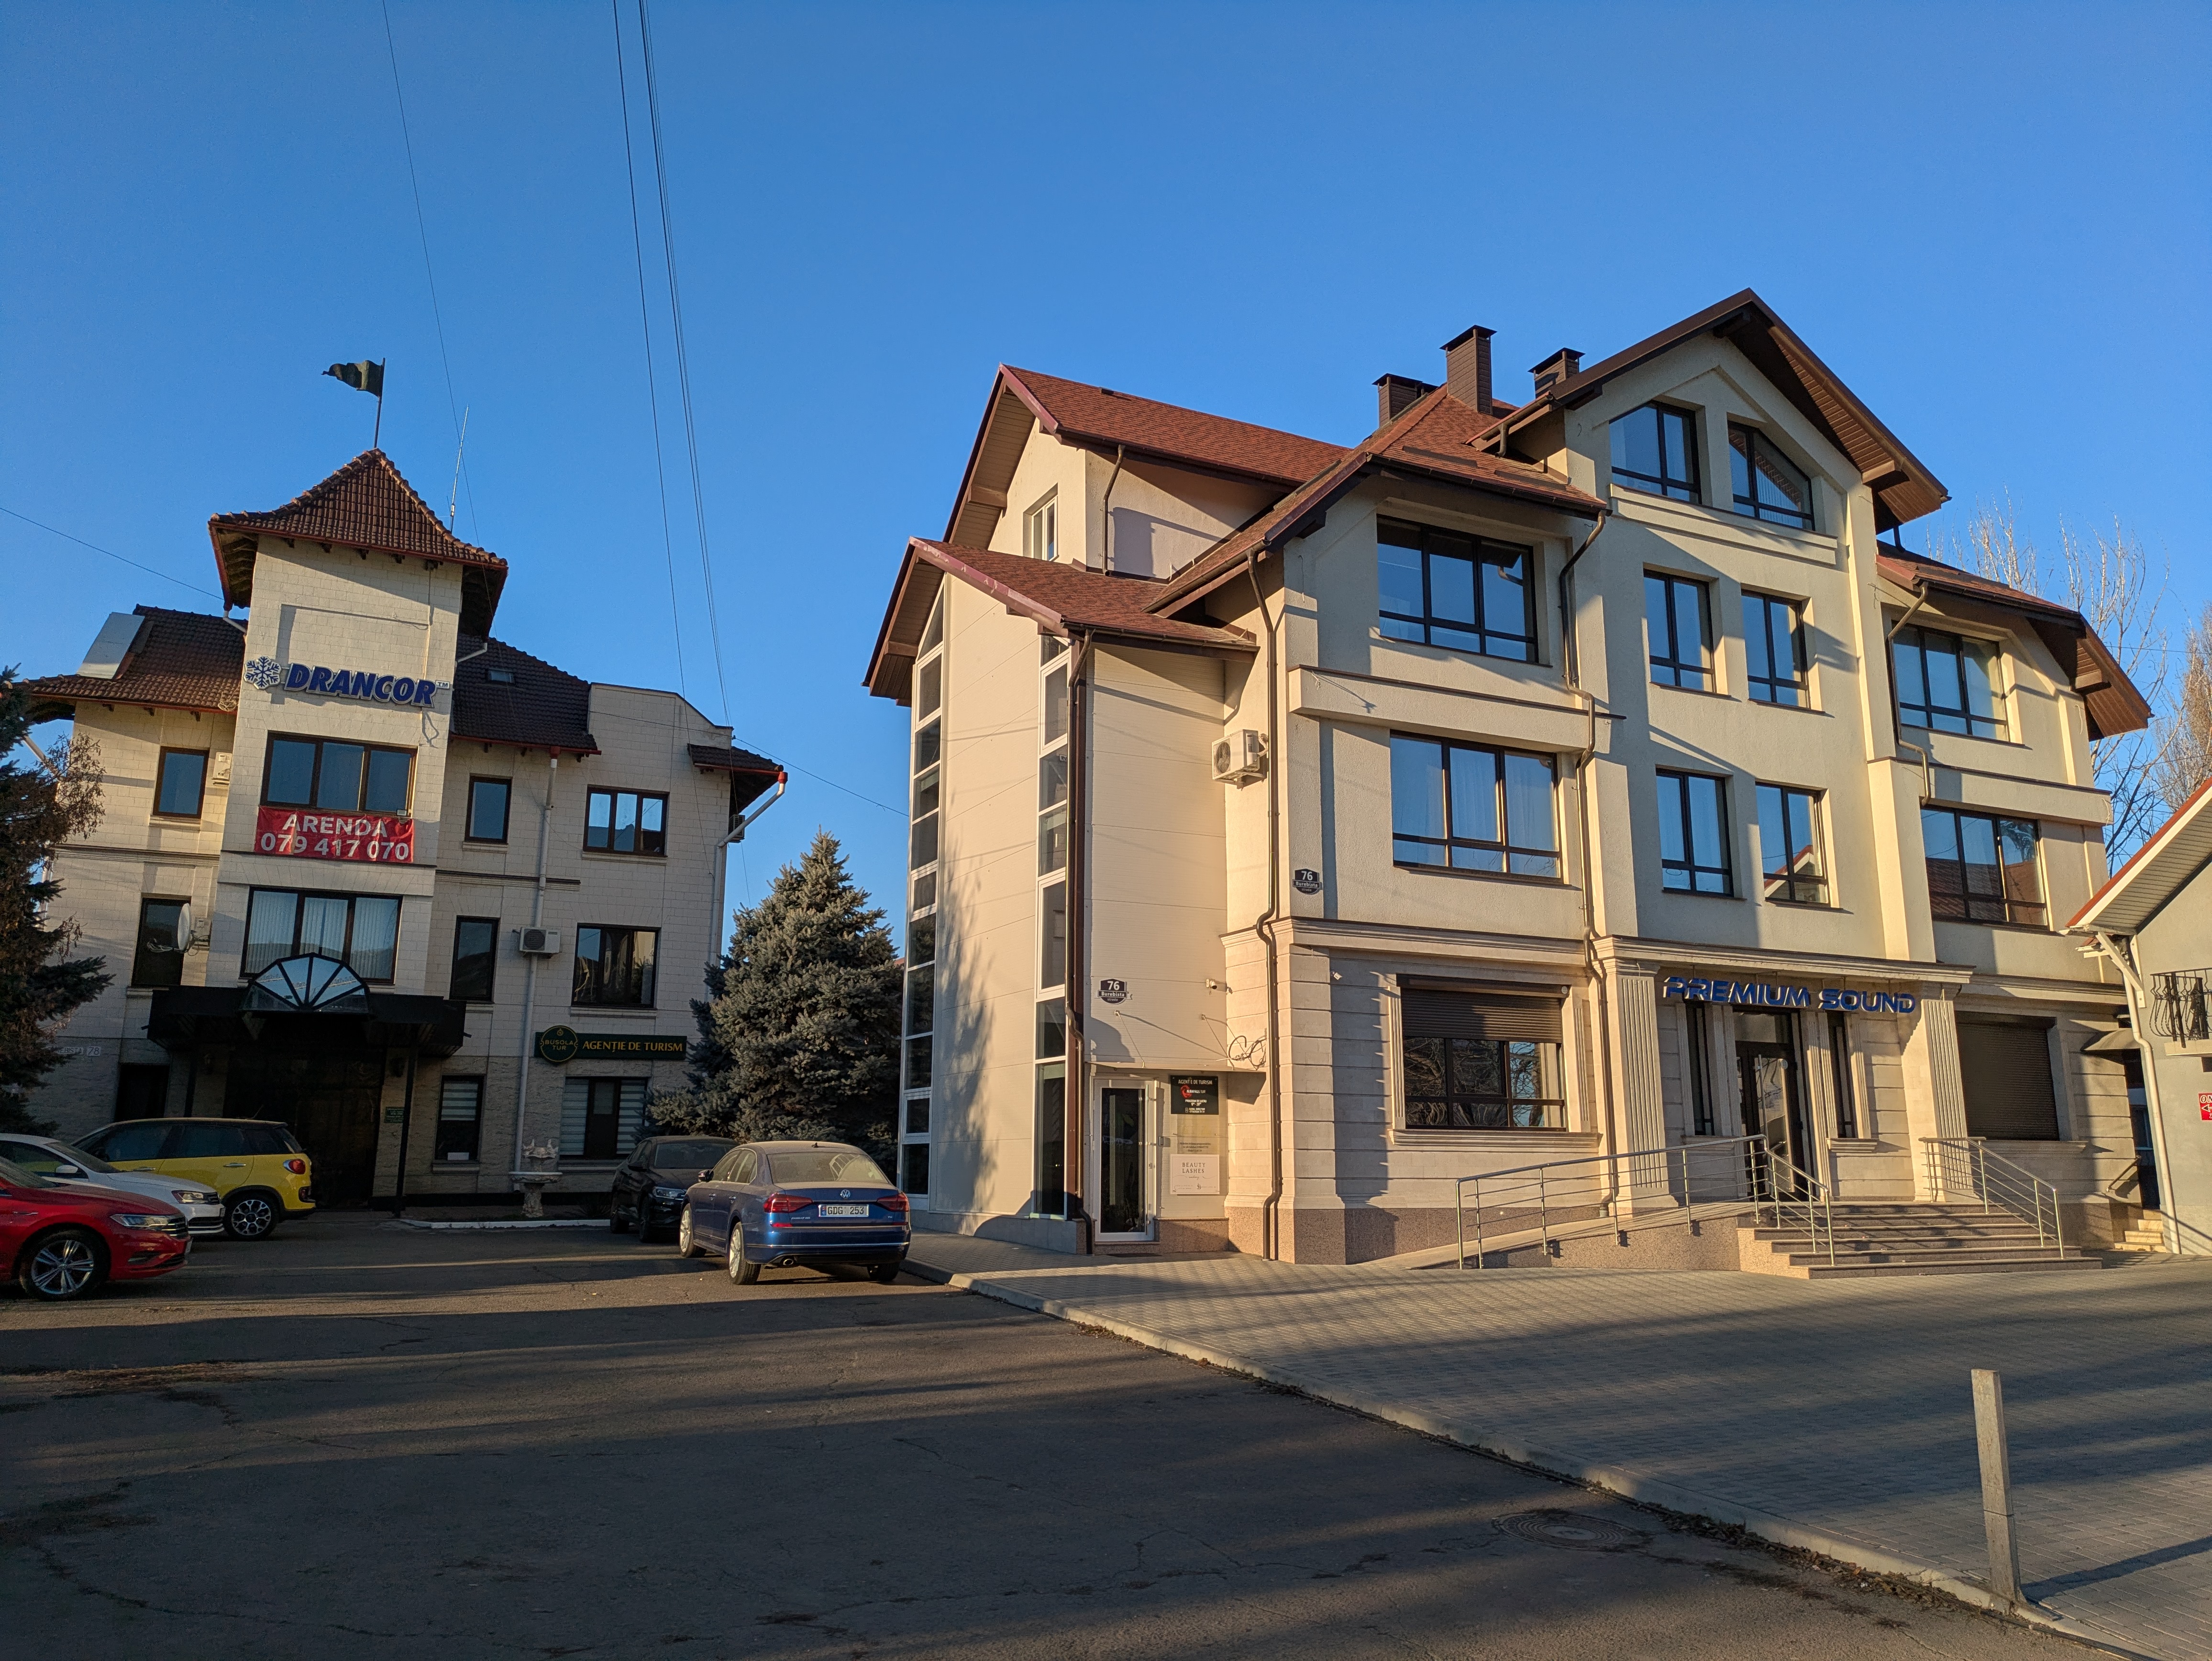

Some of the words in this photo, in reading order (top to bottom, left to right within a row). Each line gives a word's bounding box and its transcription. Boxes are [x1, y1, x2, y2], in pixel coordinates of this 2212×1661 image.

[284, 663, 436, 707] DRANCOR
[282, 814, 387, 837] ARENDA
[261, 833, 307, 853] 079
[314, 839, 360, 857] 417
[367, 841, 409, 860] 070
[1301, 871, 1313, 881] 76
[1107, 981, 1120, 991] 76
[1663, 976, 1810, 1008] PREMIUM
[1818, 988, 1916, 1013] SOUND
[88, 1047, 100, 1055] 78
[582, 1041, 626, 1052] AGENȚIE
[628, 1041, 641, 1051] DE
[644, 1042, 683, 1052] TURISM
[827, 1207, 843, 1215] GDG
[850, 1207, 864, 1215] 253
